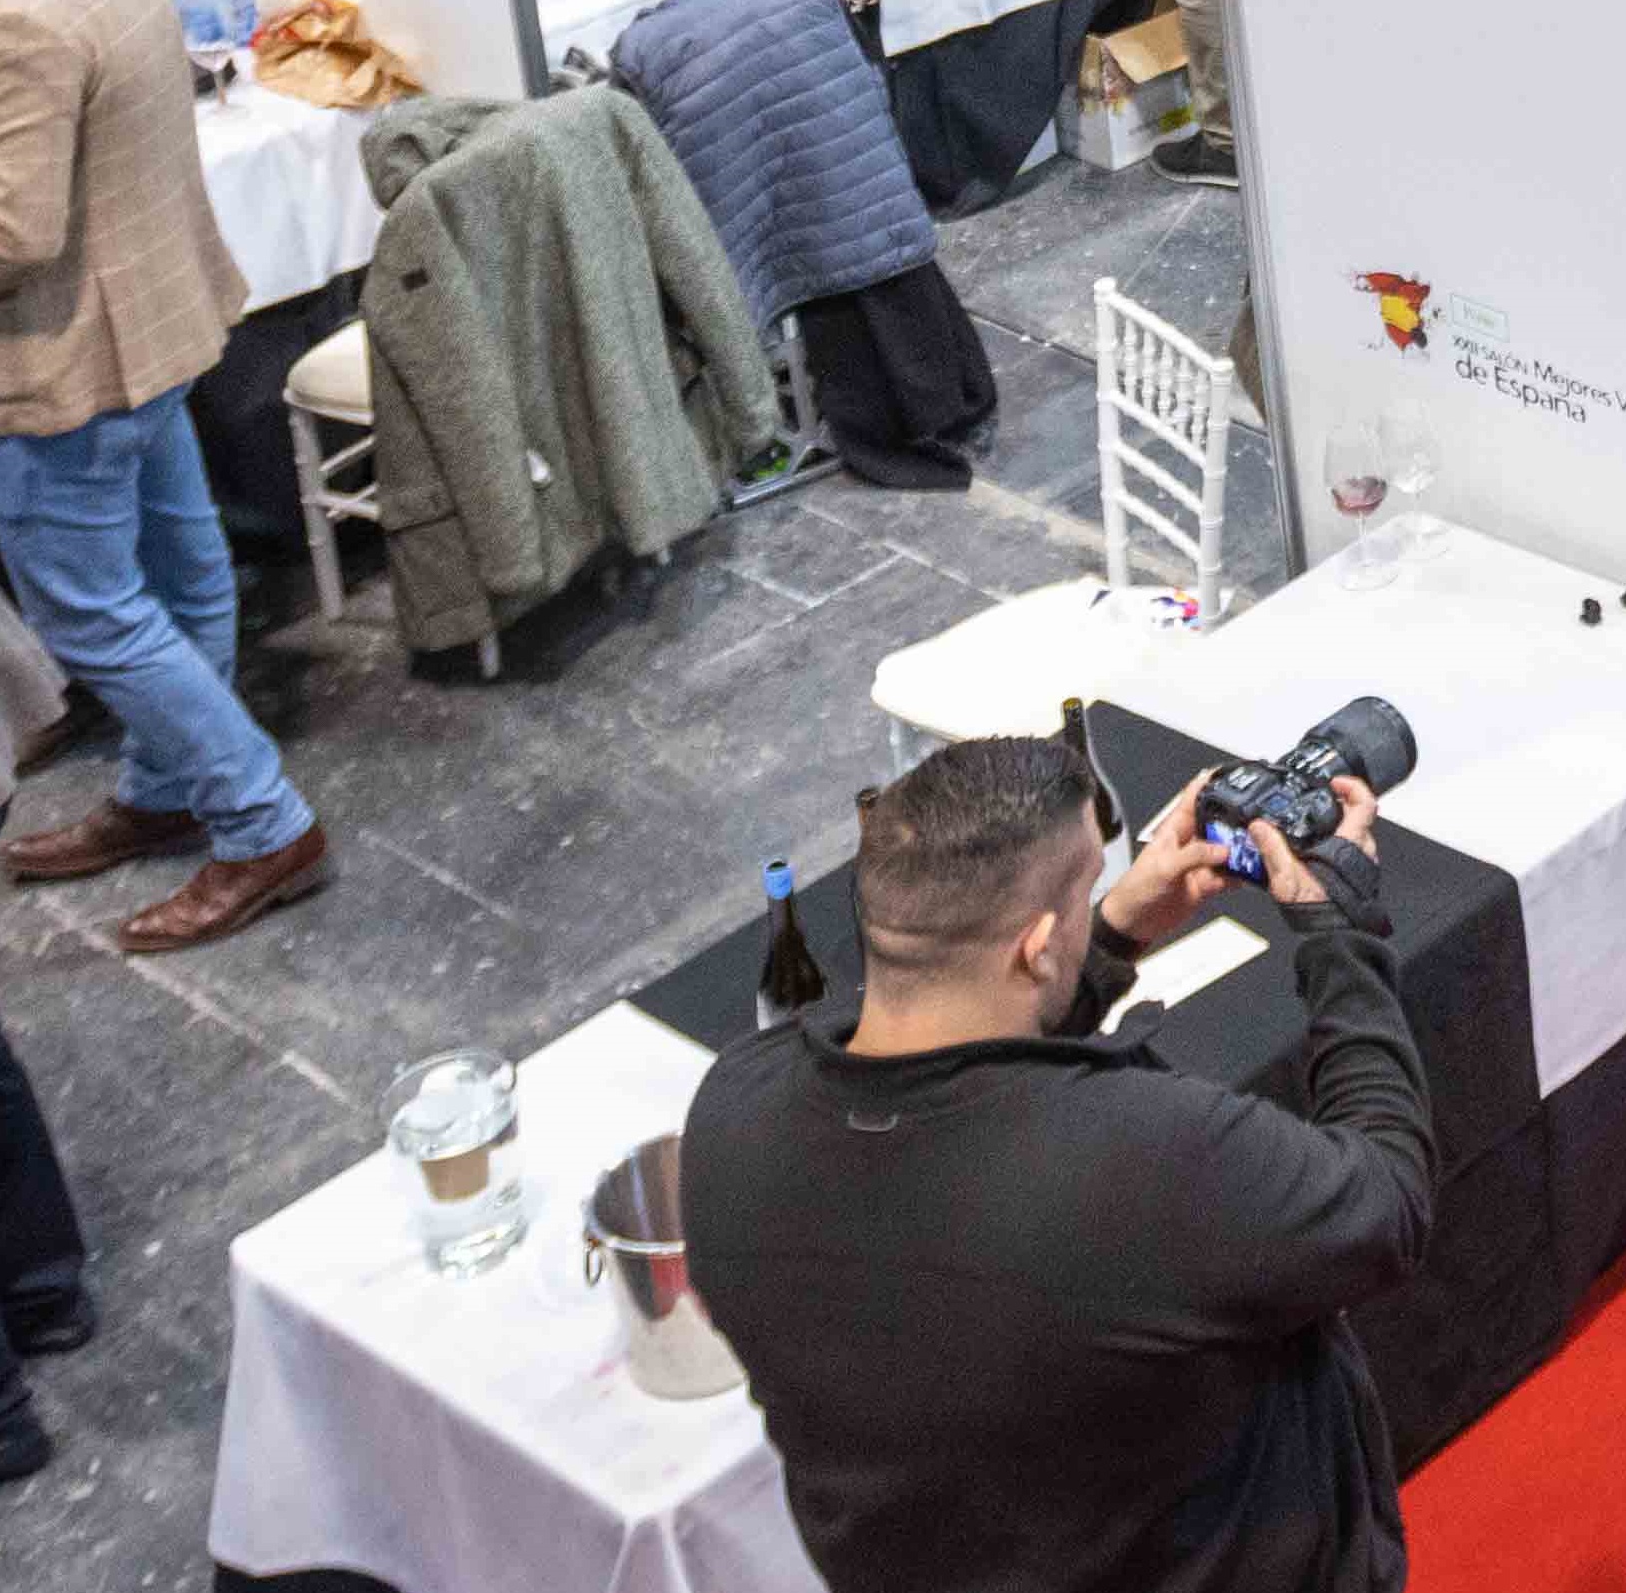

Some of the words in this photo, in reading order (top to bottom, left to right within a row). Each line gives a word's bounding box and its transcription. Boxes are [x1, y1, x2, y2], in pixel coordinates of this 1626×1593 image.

[1455, 355, 1487, 385] de
[1493, 364, 1586, 423] España
[1533, 359, 1612, 408] Mejores
